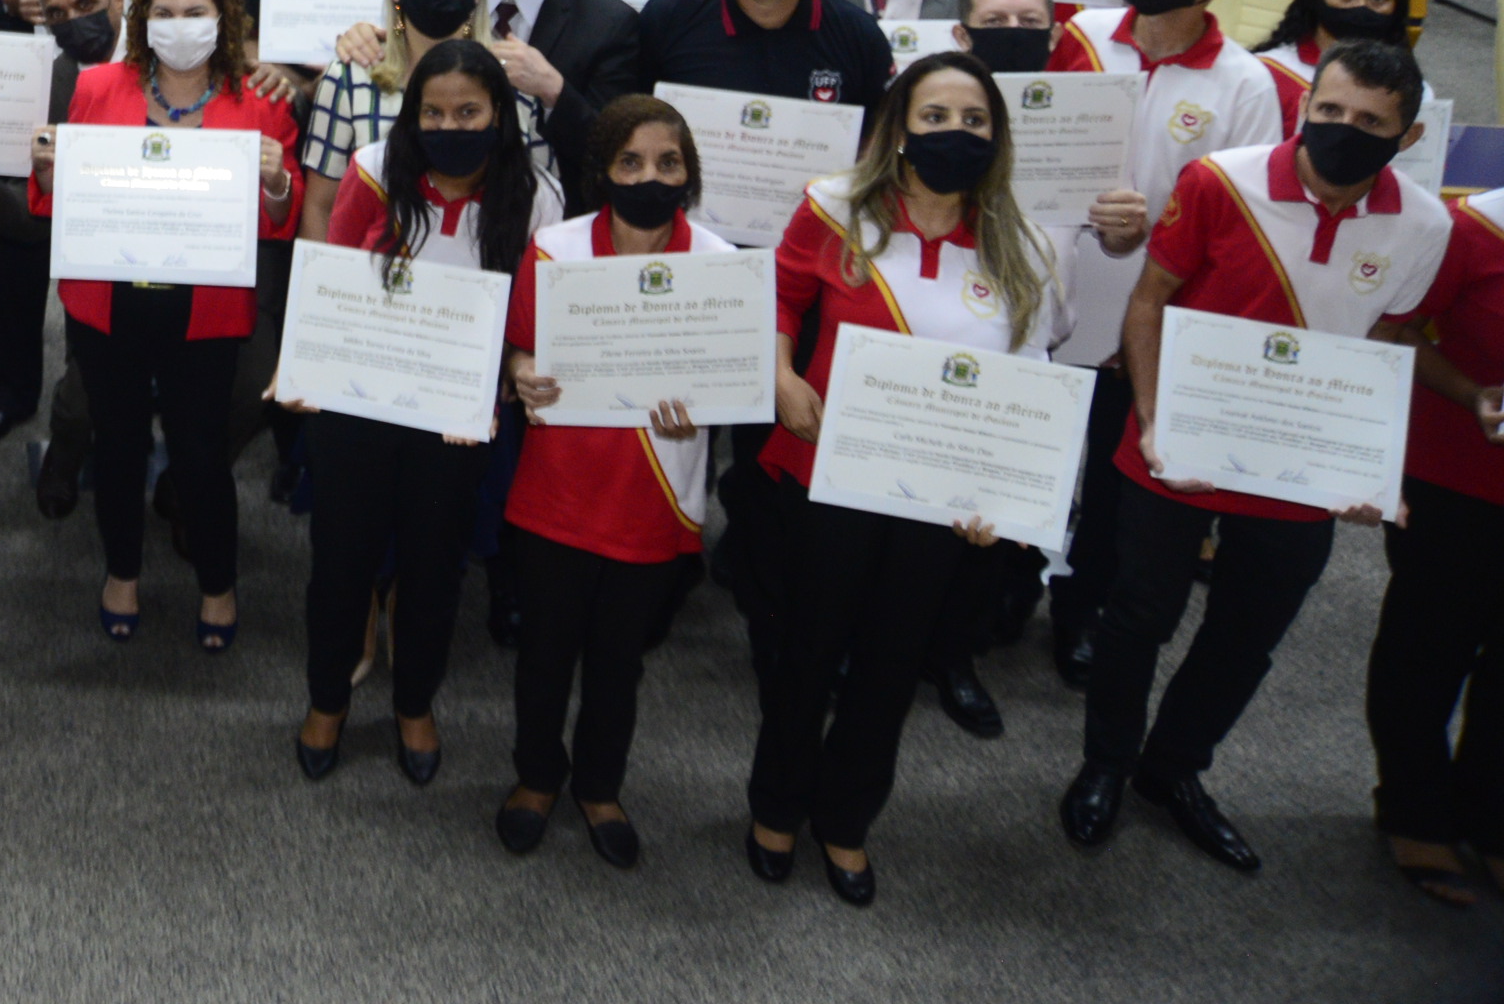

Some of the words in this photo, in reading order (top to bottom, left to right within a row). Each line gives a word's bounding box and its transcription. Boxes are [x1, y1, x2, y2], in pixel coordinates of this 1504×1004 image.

[567, 301, 620, 316] Diploma
[623, 302, 637, 314] de
[642, 300, 680, 314] Honra
[683, 300, 698, 311] ao
[702, 295, 745, 311] Mérito
[863, 374, 918, 397] Diploma
[921, 385, 936, 400] de
[940, 388, 983, 407] Honra
[985, 399, 1001, 412] ao
[1004, 400, 1051, 422] Mérito
